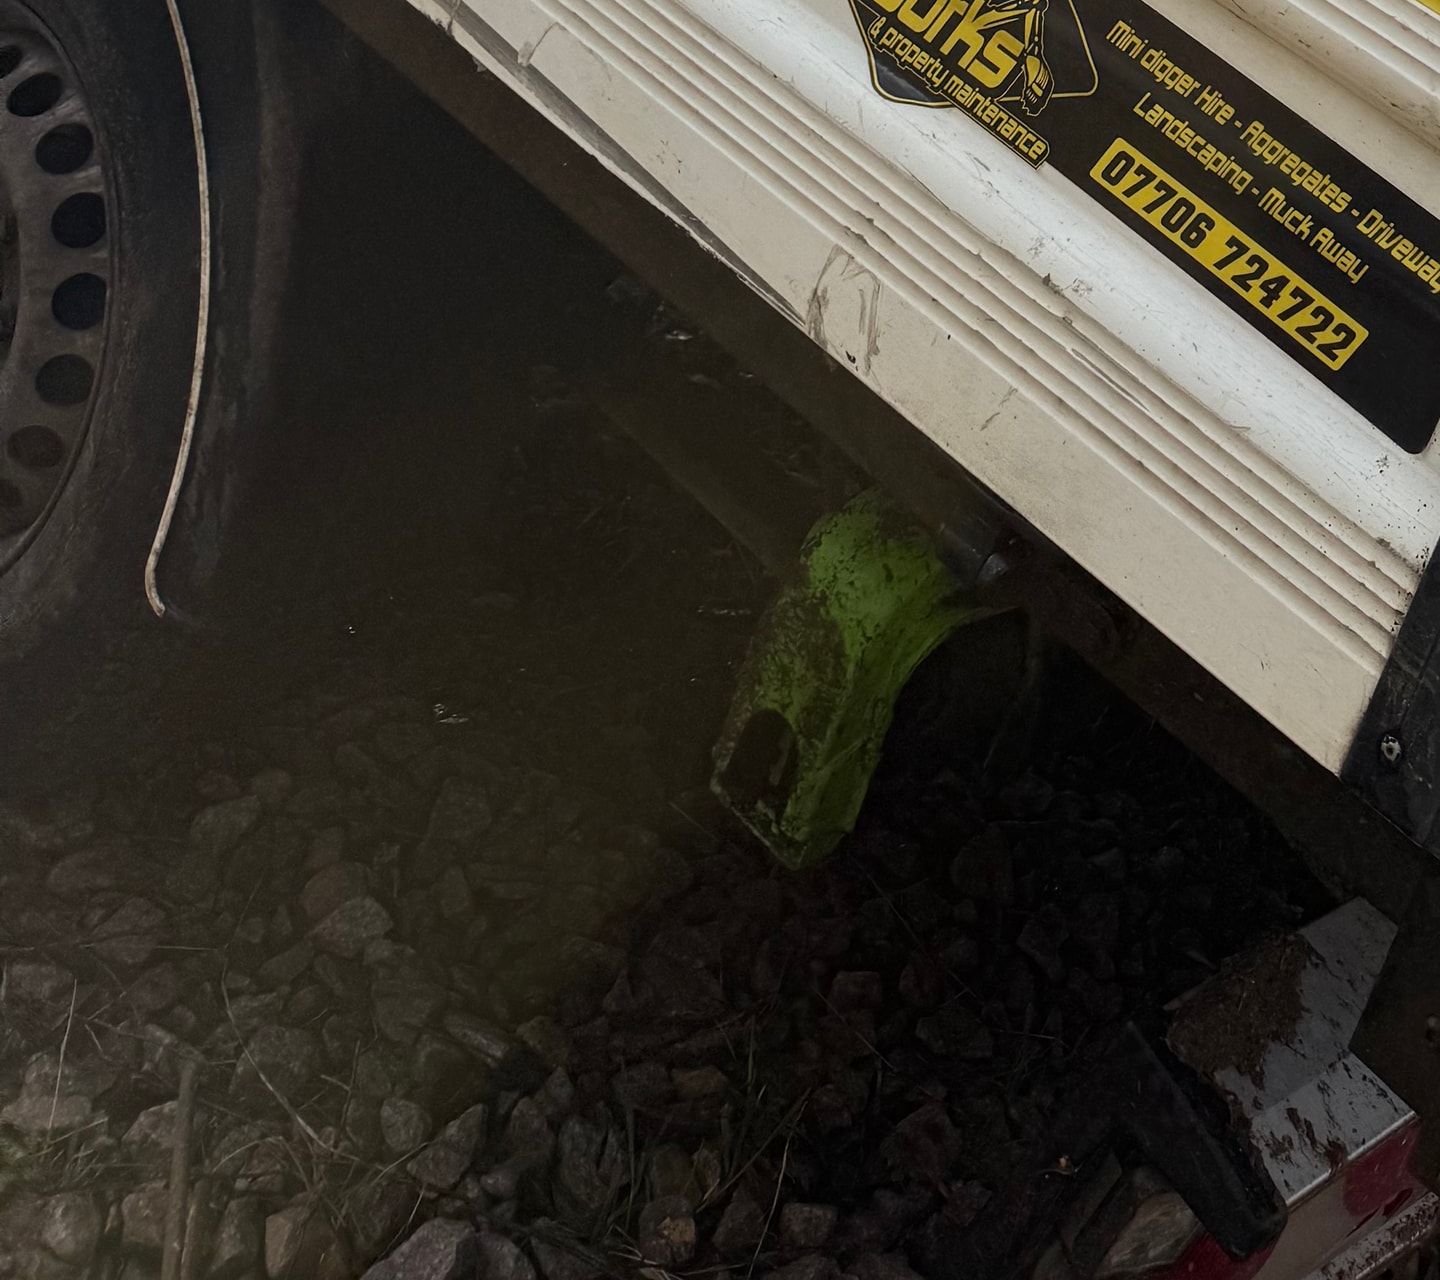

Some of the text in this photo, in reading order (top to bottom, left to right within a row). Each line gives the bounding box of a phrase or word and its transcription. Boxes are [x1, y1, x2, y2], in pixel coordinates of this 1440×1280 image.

[872, 16, 1046, 161] & property maintenance
[1106, 20, 1149, 61] Mini
[1140, 46, 1202, 99] digger
[1193, 86, 1237, 125] Hire
[1240, 120, 1352, 214] Aggregates
[1101, 150, 1358, 363] 07706 724722
[1133, 92, 1253, 196] Landscaping
[1257, 187, 1313, 242] Muck
[1309, 229, 1370, 284] Away
